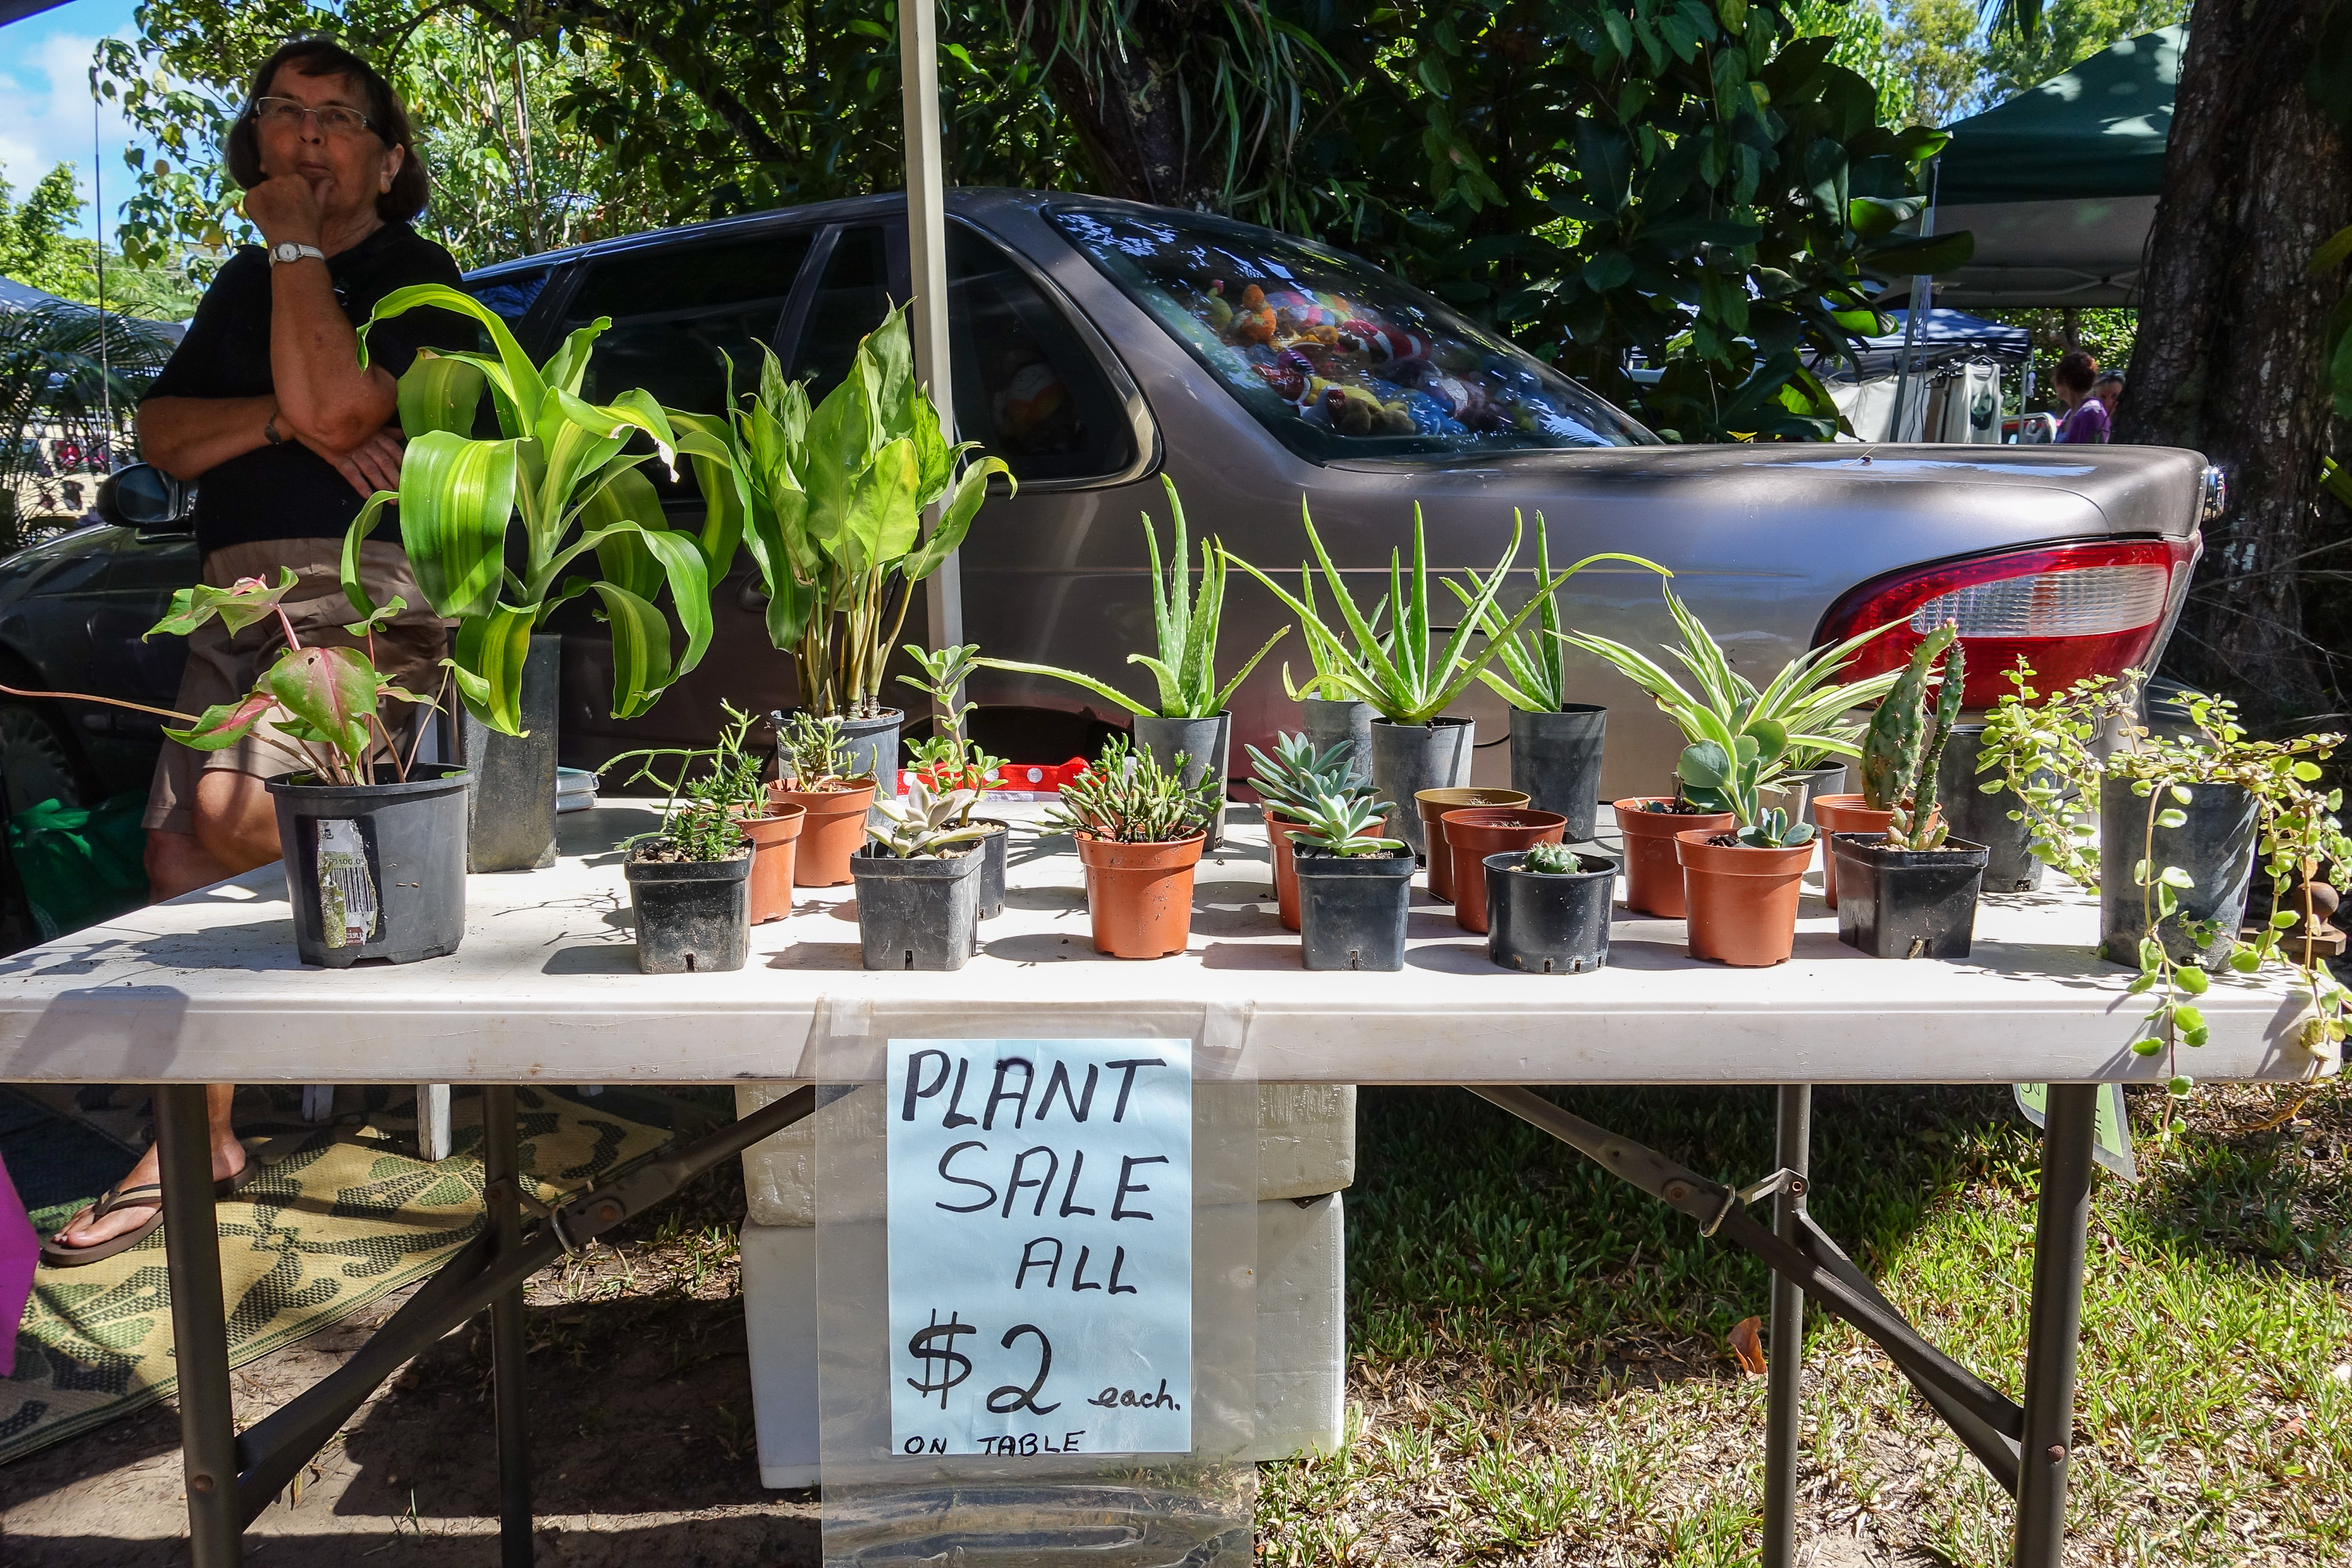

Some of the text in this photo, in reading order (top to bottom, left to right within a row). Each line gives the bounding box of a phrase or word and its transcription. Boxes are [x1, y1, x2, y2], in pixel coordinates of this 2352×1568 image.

[902, 1048, 1167, 1131] PLANT
[935, 1141, 1170, 1221] SALE
[1015, 1237, 1137, 1294] ALL
[1087, 1378, 1181, 1411] each.
[904, 1430, 1087, 1457] ON TABLE
